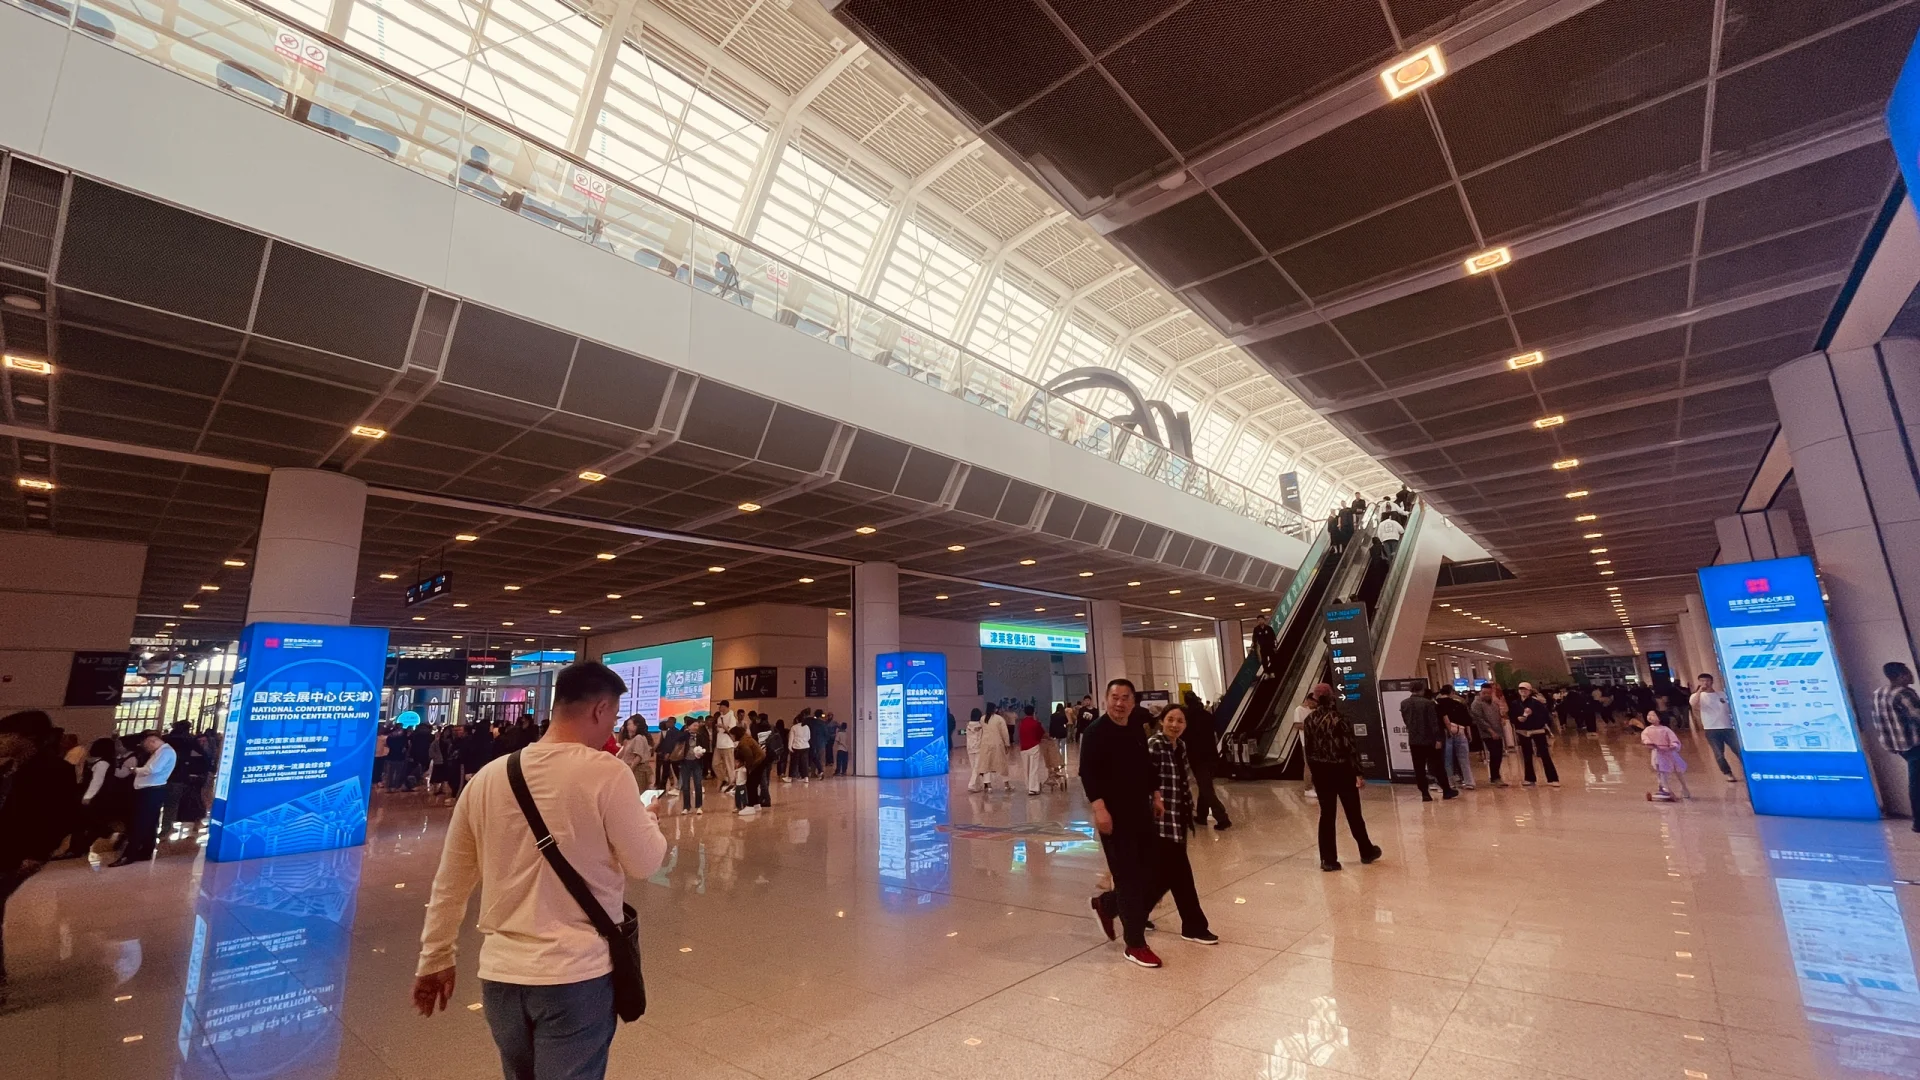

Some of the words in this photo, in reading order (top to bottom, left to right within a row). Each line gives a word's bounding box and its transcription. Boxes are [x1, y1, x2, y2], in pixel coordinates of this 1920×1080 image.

[1330, 630, 1339, 638] 2F
[1333, 649, 1342, 657] 1F
[417, 671, 440, 681] N18
[666, 670, 684, 686] 2025
[735, 674, 758, 692] N17
[253, 691, 373, 704] 国家会展中心(天津)
[250, 713, 301, 721] EXHIBITION
[301, 712, 332, 720] CENTER
[333, 712, 370, 720] (TIANJIN)
